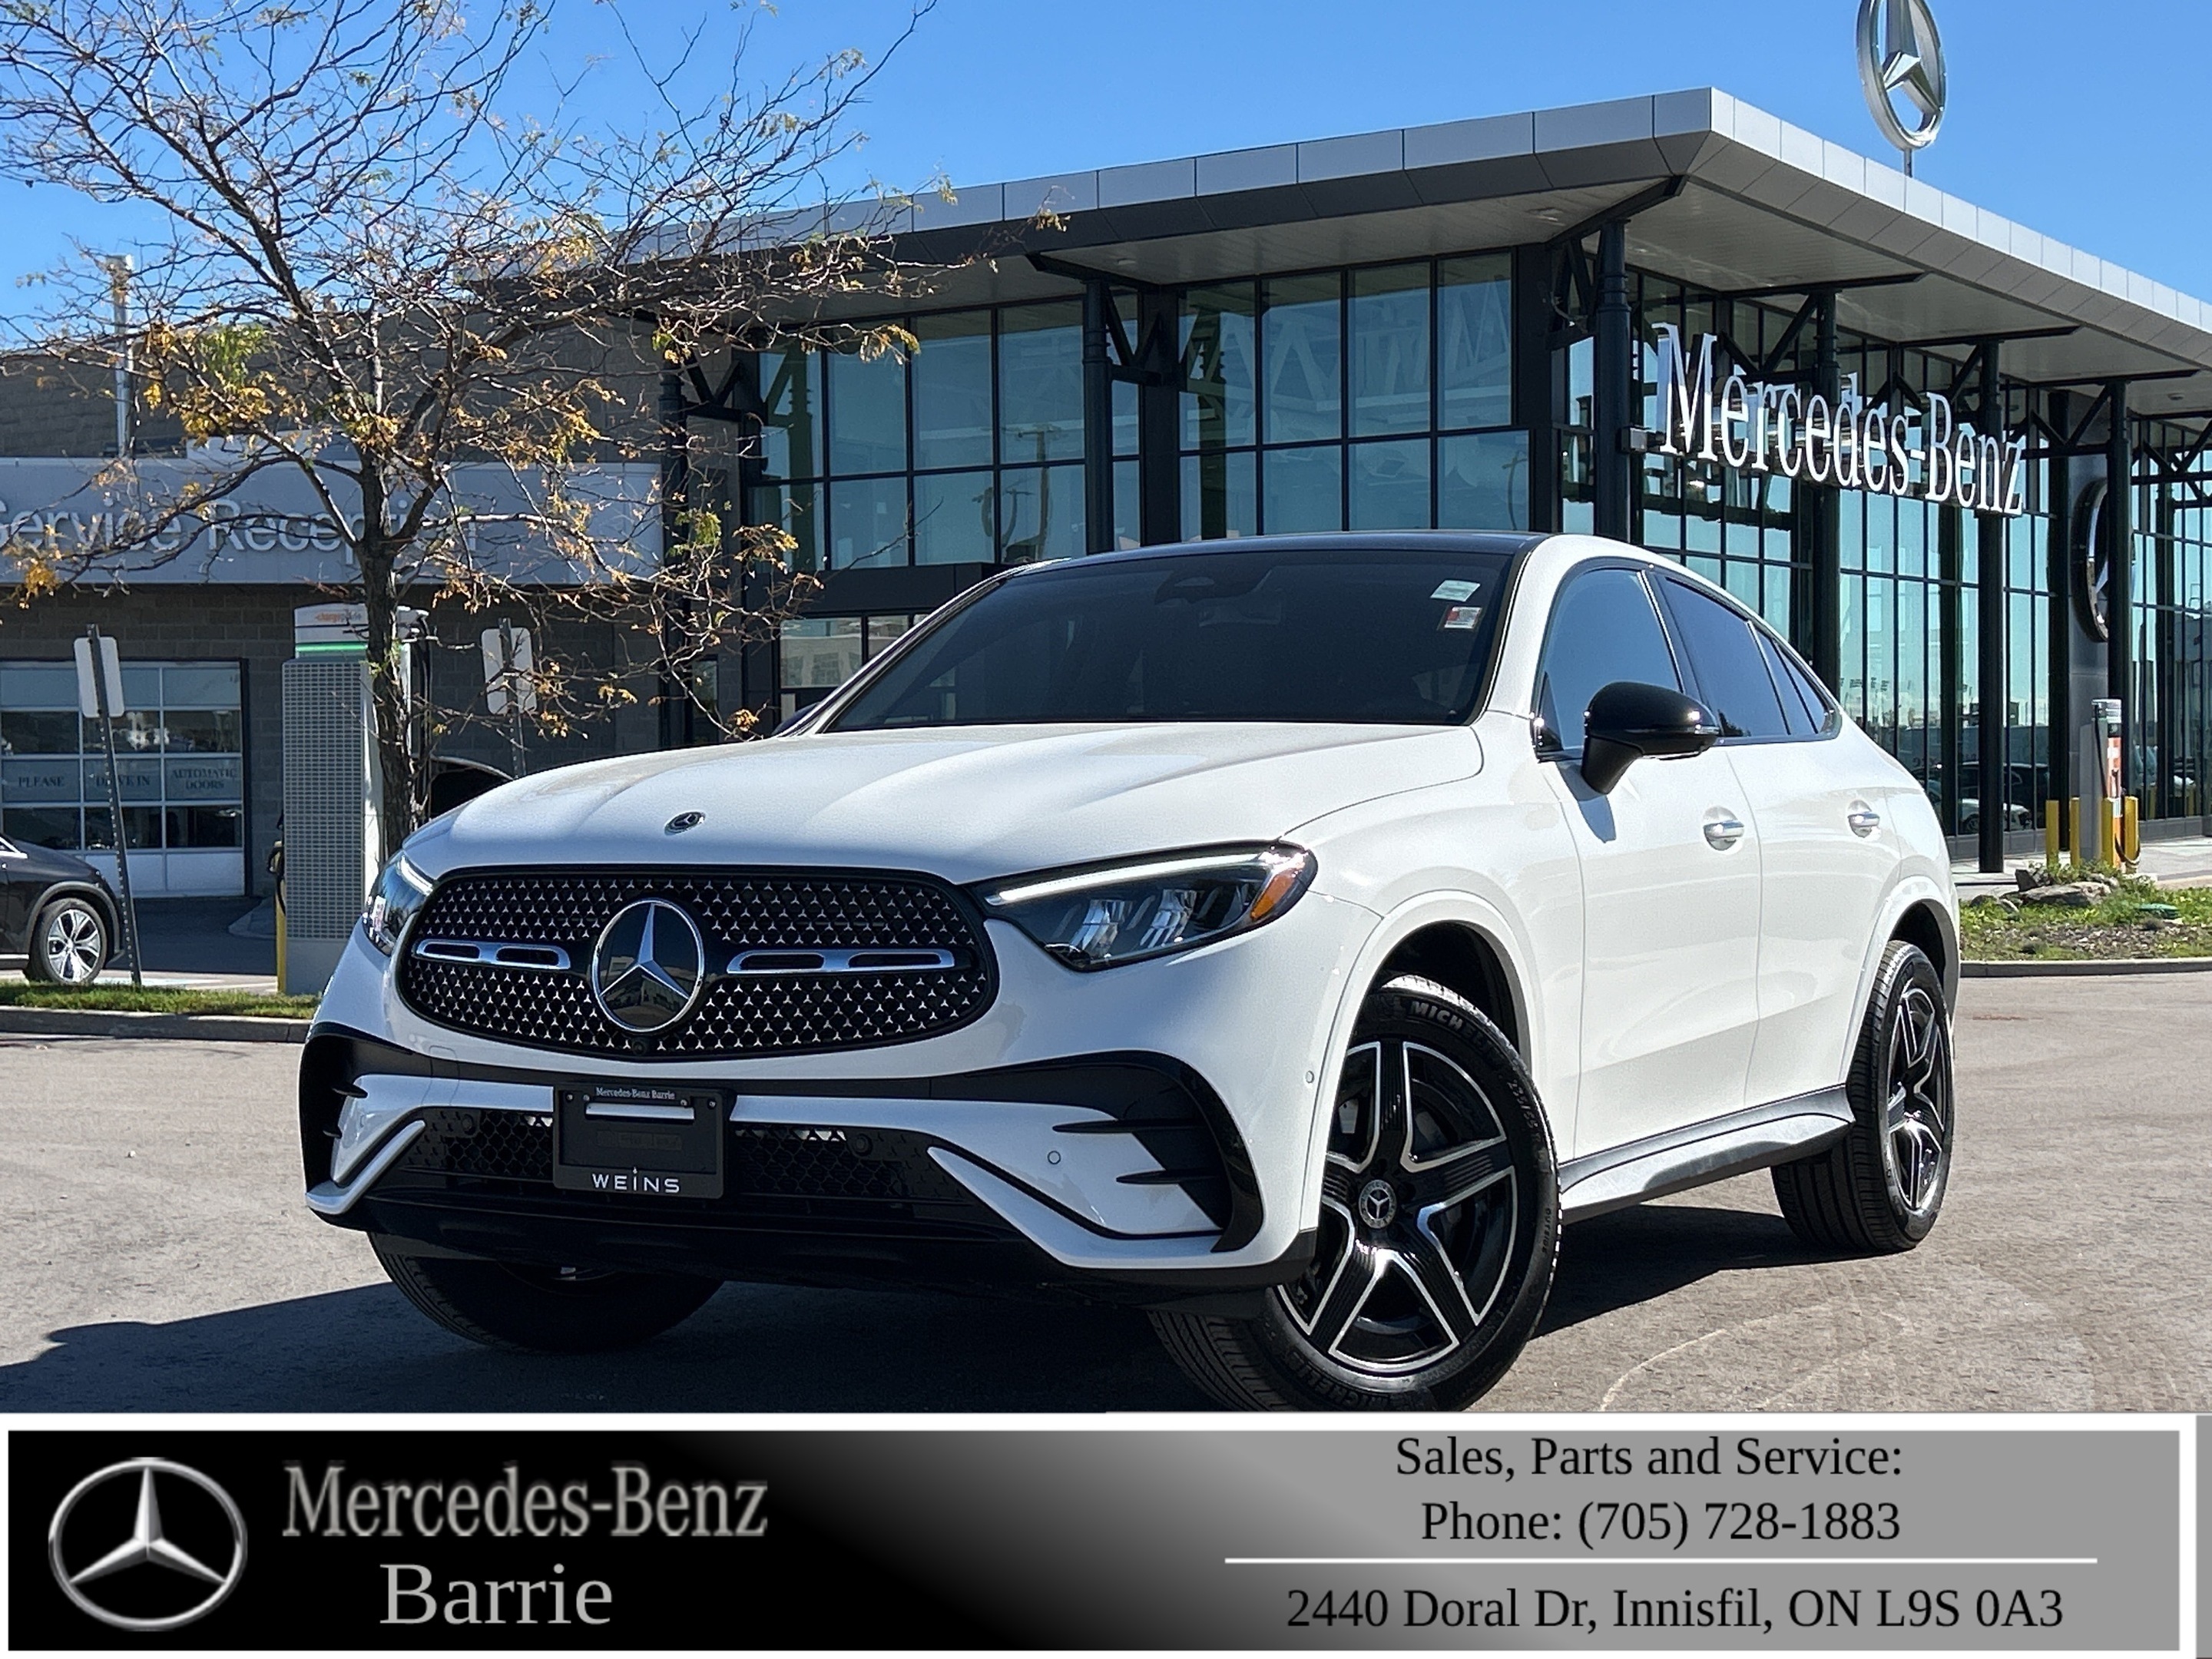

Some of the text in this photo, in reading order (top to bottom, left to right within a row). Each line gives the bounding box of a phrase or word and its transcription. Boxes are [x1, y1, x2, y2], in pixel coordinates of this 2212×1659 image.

[1651, 321, 2024, 515] Mercedes-Benz
[0, 499, 181, 552] ervice
[595, 1086, 676, 1100] Mercedes-Benz Barrie
